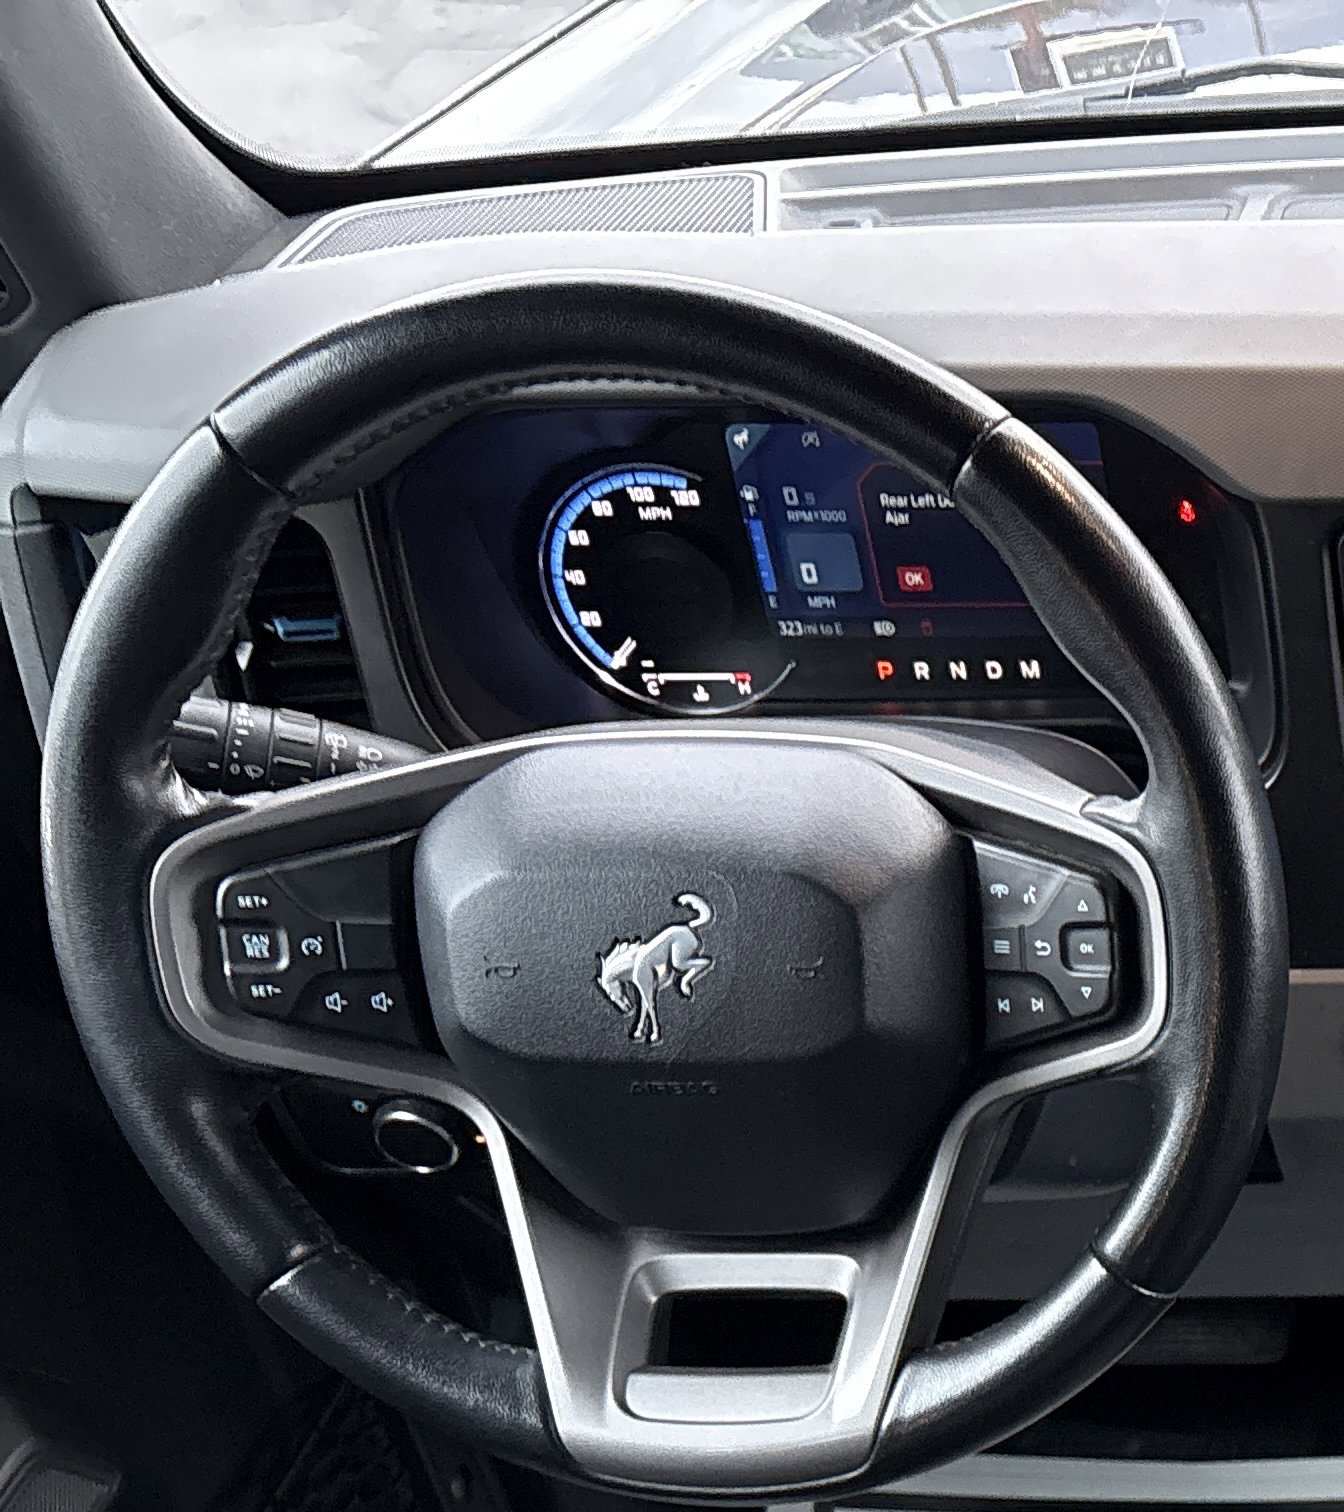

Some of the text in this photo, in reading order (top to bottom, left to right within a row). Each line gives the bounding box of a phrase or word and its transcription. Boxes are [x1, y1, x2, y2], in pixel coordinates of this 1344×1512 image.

[626, 486, 655, 502] 100
[879, 492, 908, 508] Rear
[910, 493, 936, 508] Left
[638, 506, 673, 521] MPH
[885, 510, 910, 527] Ajar
[564, 569, 586, 586] 40
[799, 562, 818, 585] 0
[904, 571, 924, 586] OK
[806, 595, 837, 609] MPH
[778, 620, 803, 636] 323
[877, 660, 894, 681] P
[914, 660, 930, 680] R
[950, 660, 967, 680] N
[986, 660, 1002, 680] D
[1020, 660, 1041, 679] M
[1079, 942, 1095, 954] OK
